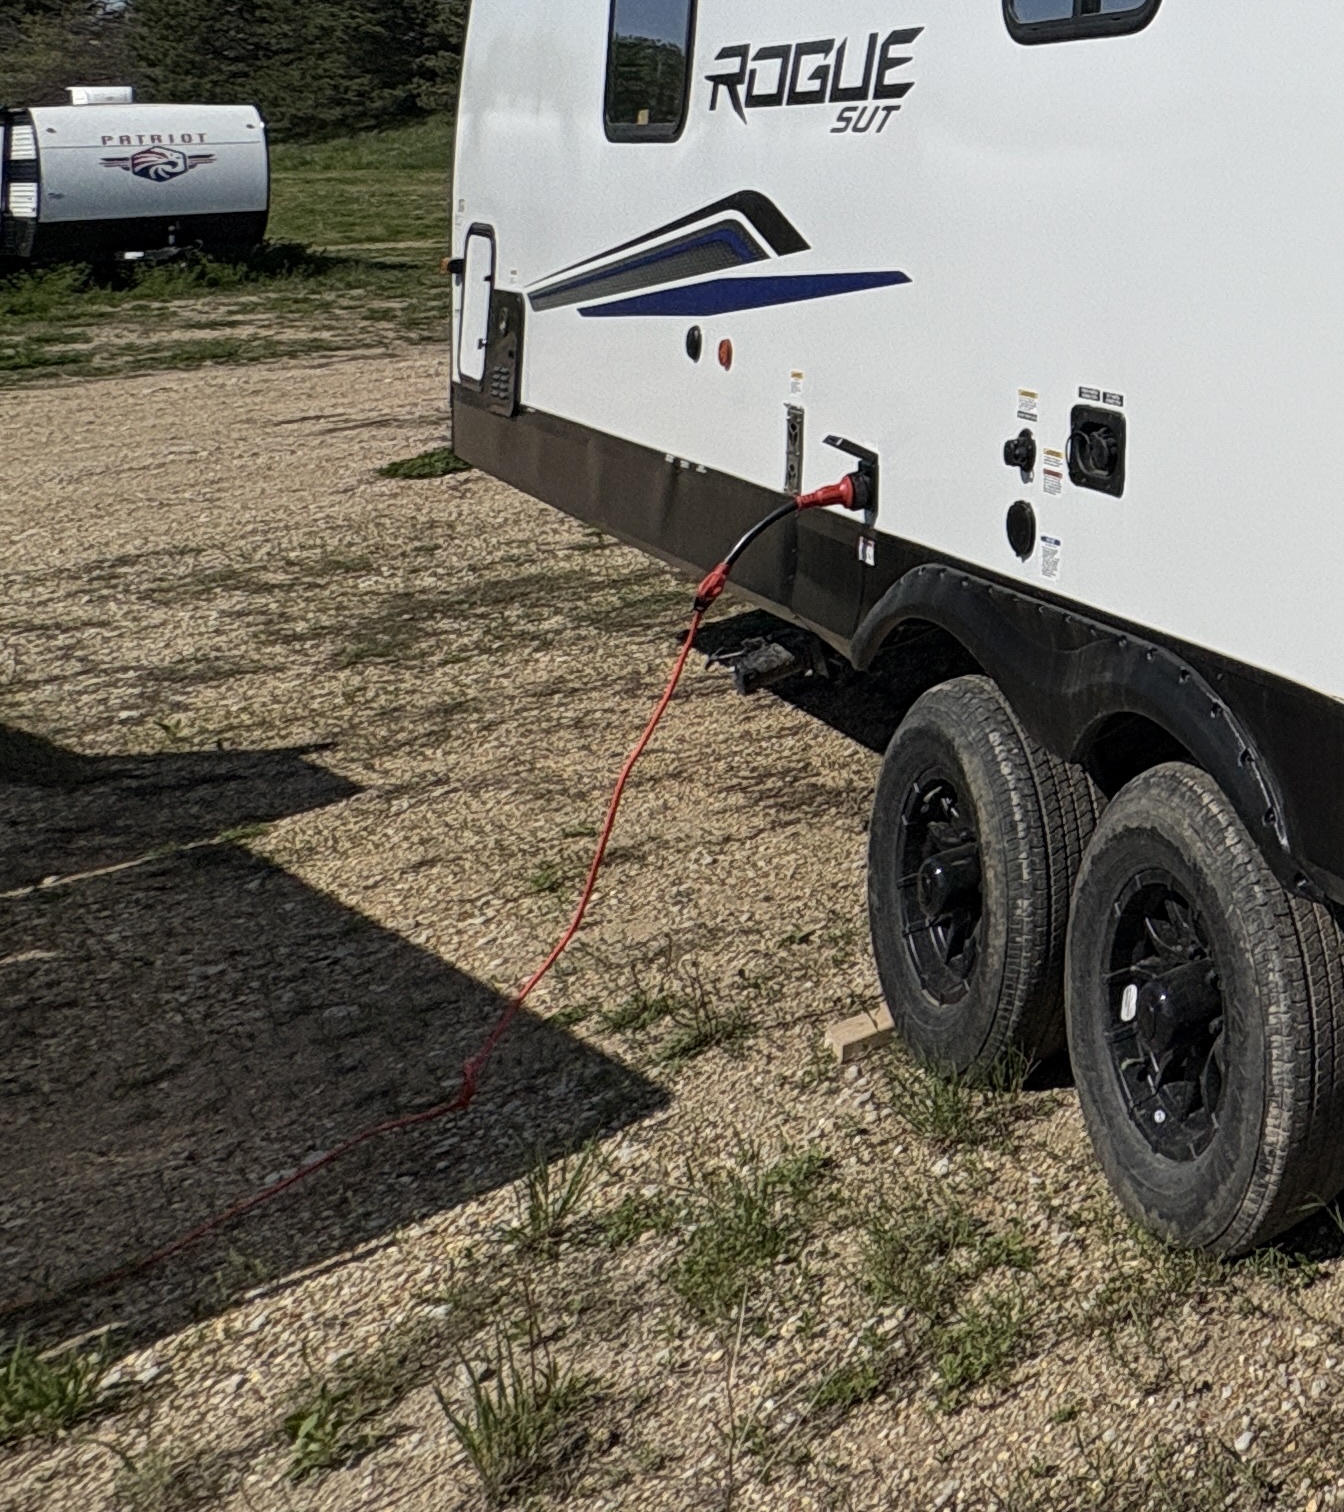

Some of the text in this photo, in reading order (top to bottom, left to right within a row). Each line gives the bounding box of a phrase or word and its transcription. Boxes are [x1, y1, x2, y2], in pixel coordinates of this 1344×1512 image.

[704, 26, 925, 125] ROGUE
[829, 105, 902, 134] SUT
[101, 133, 206, 146] PATRIOT
